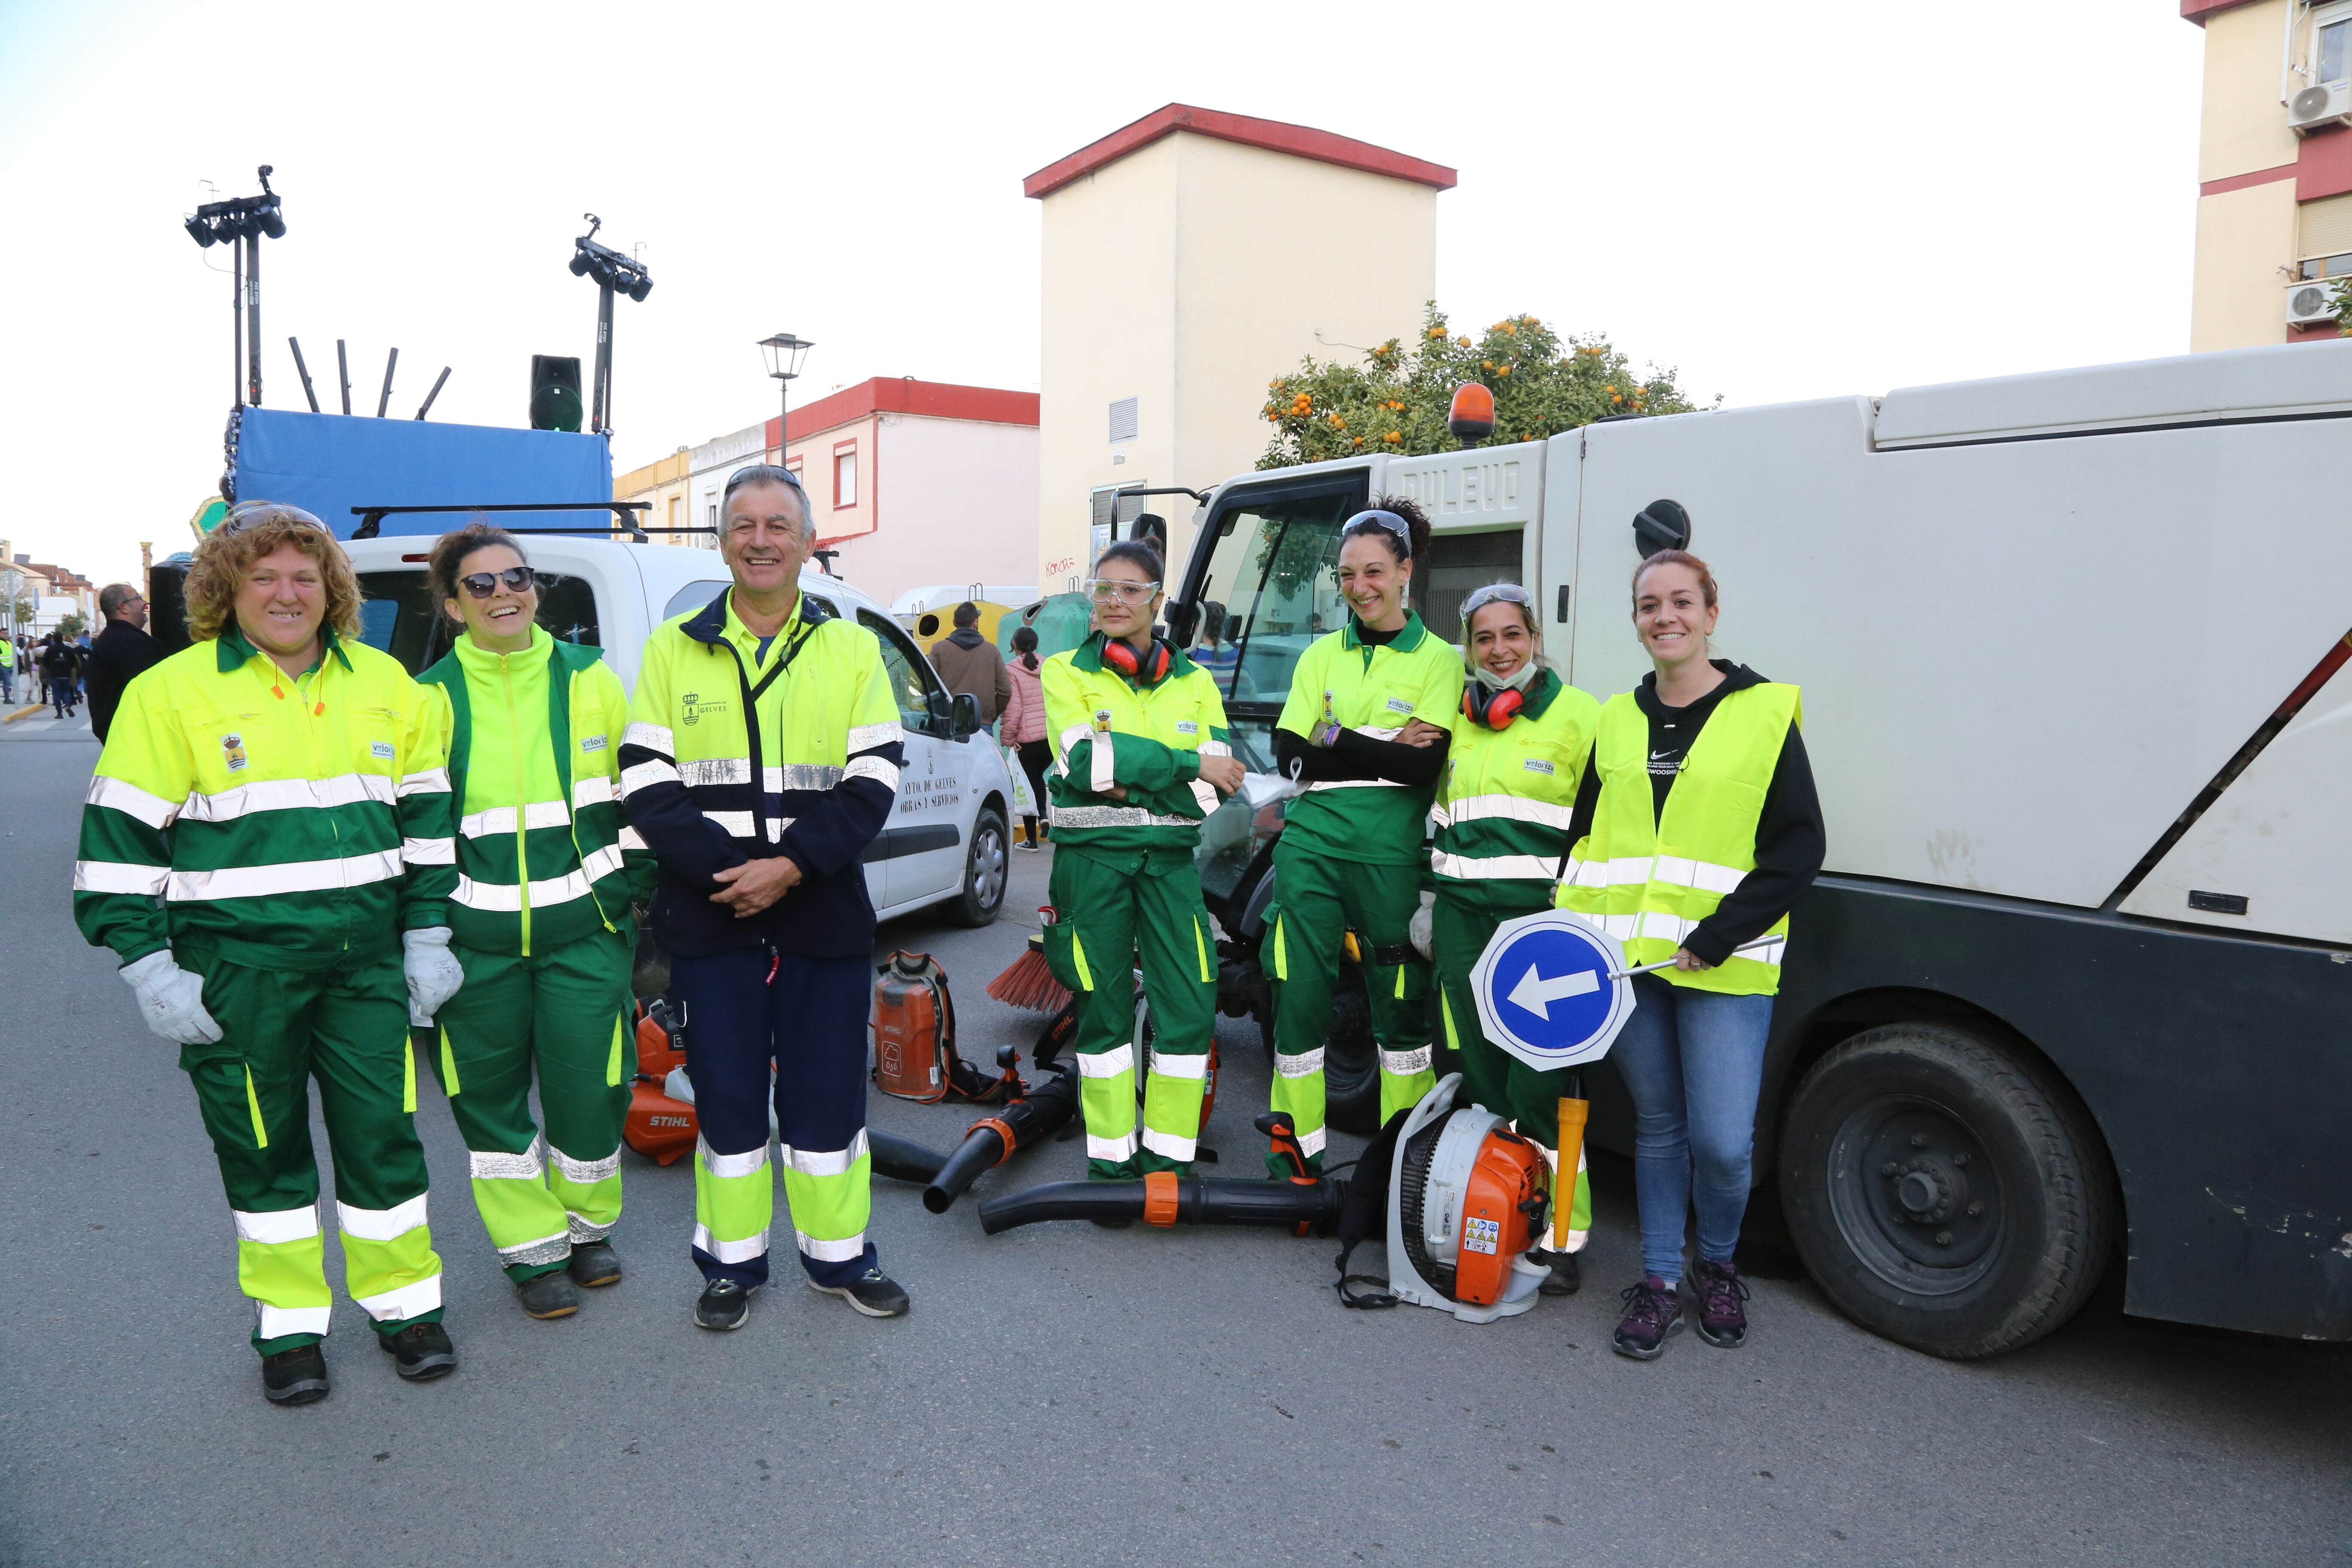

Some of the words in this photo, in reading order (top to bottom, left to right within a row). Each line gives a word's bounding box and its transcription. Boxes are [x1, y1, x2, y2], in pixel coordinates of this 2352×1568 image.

[1389, 700, 1414, 711] valoriza
[1526, 760, 1553, 771] valoriza
[904, 781, 921, 795] AYTO.
[924, 780, 931, 792] DE
[935, 777, 956, 790] GELVES
[900, 798, 921, 814] OBRAS
[924, 796, 928, 808] Y
[931, 793, 959, 807] SERVICIOS
[885, 1025, 901, 1034] STIHL
[649, 1116, 690, 1127] STIHL
